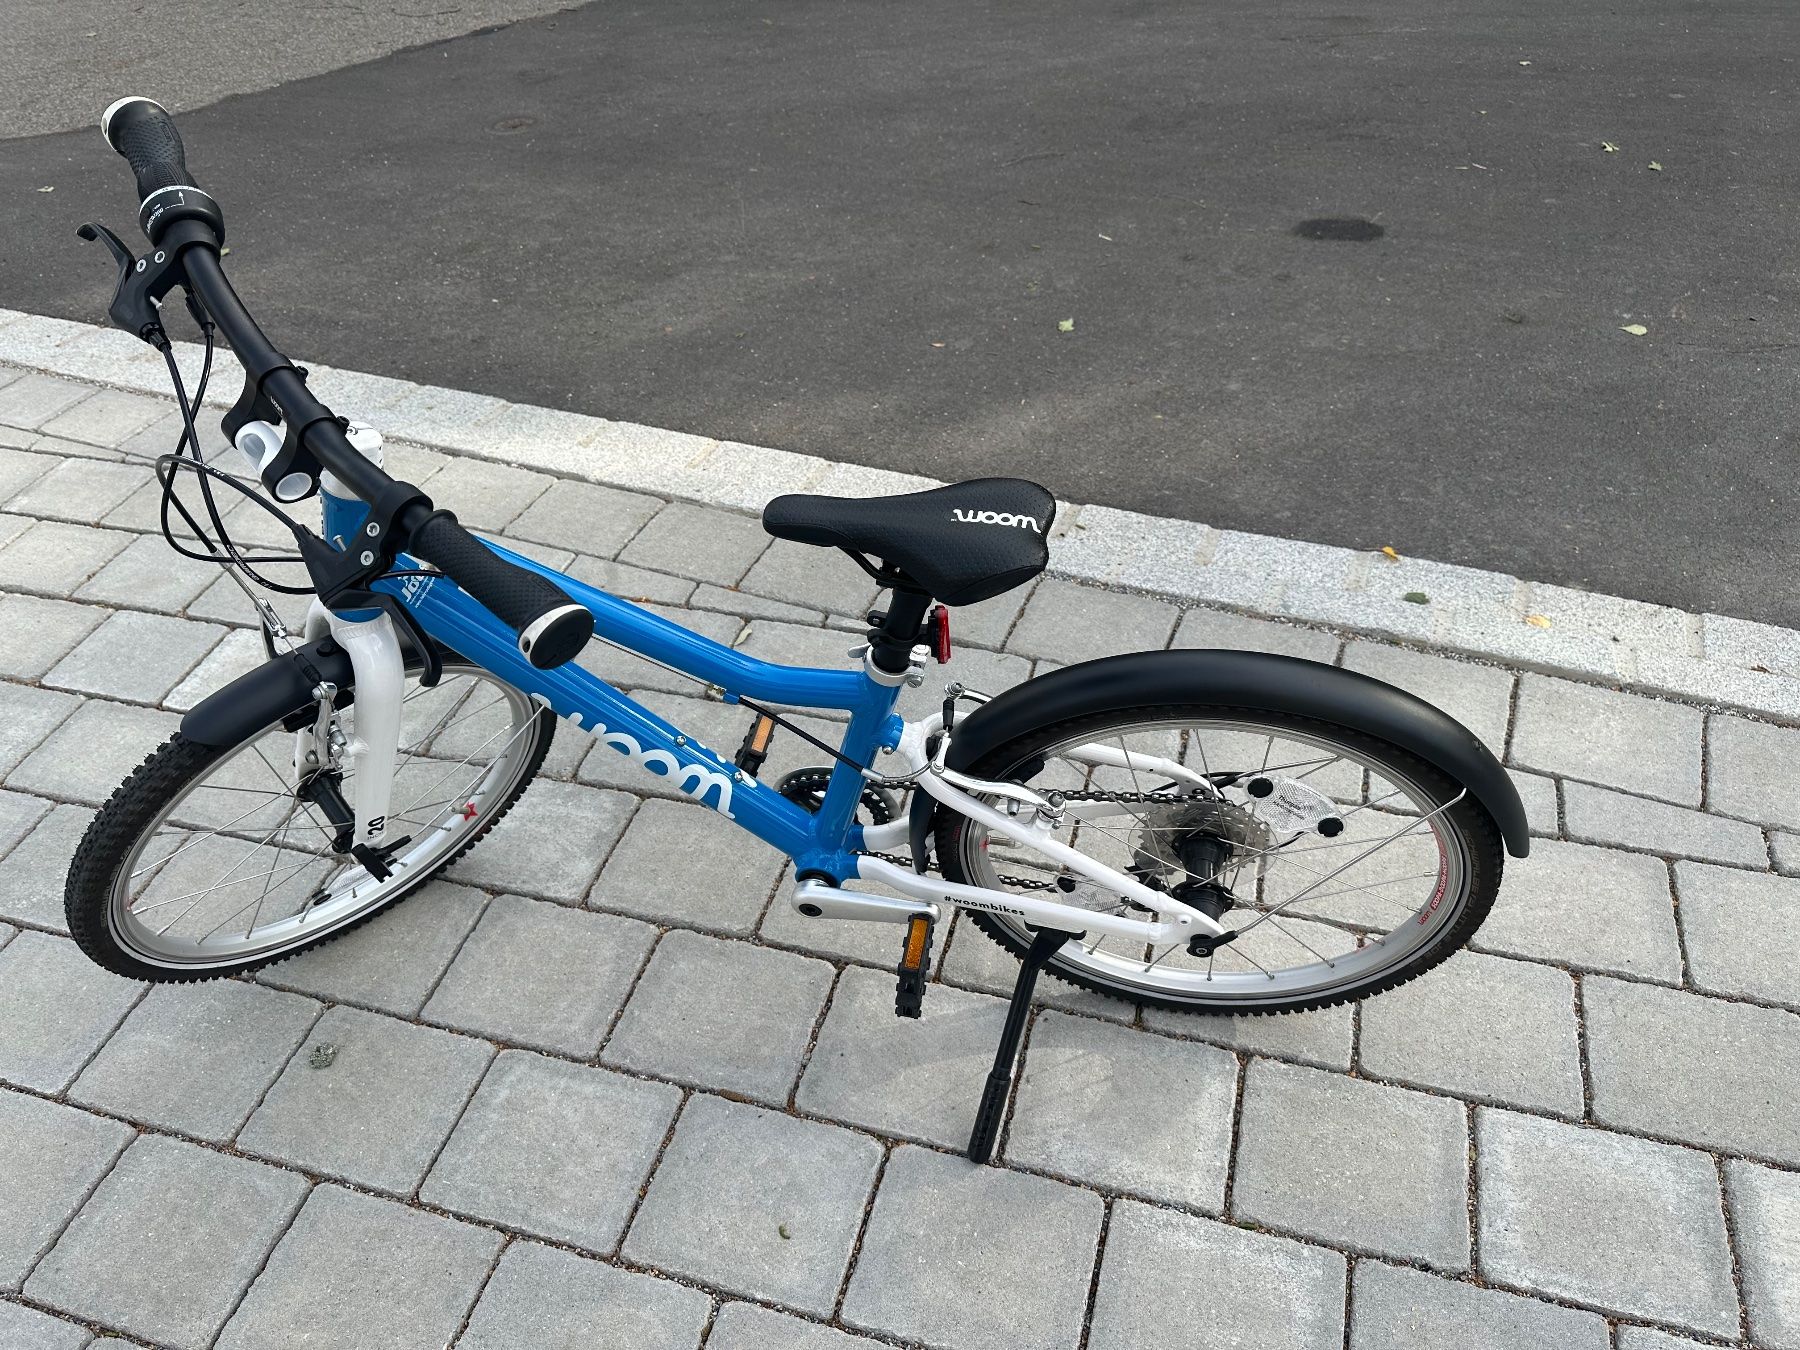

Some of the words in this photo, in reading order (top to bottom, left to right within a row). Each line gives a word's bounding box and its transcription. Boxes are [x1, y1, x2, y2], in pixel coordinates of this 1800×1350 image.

[953, 509, 1041, 533] woom
[367, 815, 385, 835] 20
[944, 896, 1025, 916] #woombikes
